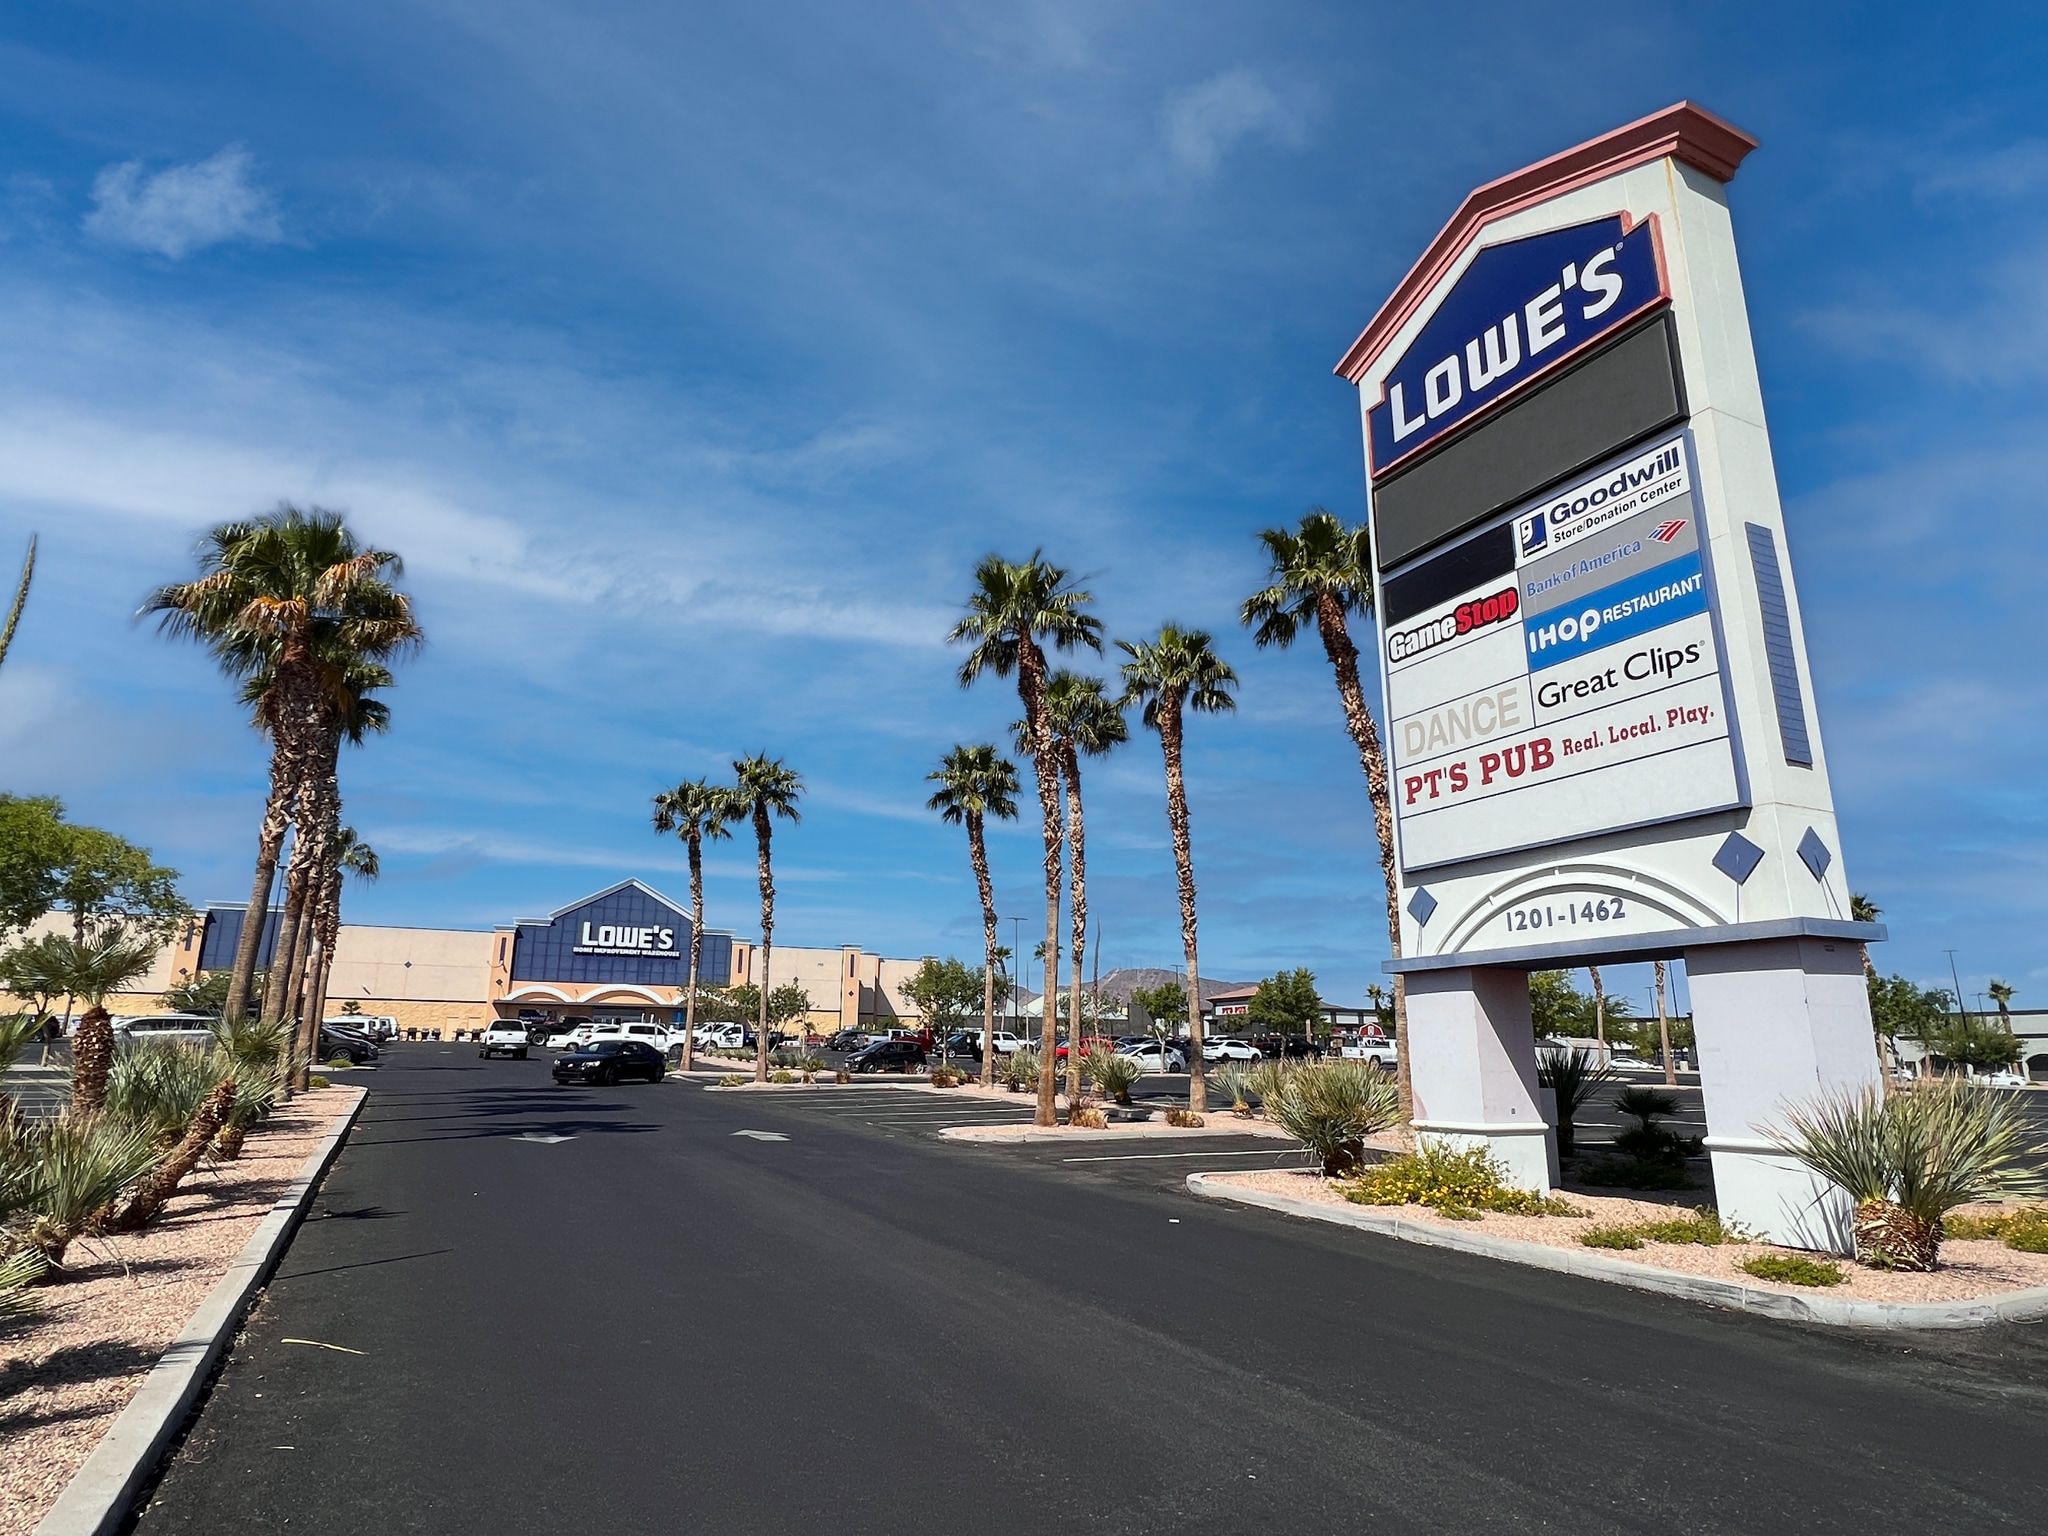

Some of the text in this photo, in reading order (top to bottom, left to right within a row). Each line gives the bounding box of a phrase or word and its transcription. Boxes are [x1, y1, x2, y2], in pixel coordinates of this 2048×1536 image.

[1390, 247, 1623, 443] LOWE'S
[1549, 447, 1680, 524] Goodwill
[1554, 478, 1682, 543] Store/Donation Center
[1526, 540, 1641, 598] Bank of America
[1388, 587, 1519, 662] GameStop
[1529, 573, 1702, 653] IHOP RESTAURANT
[1538, 643, 1700, 708] Great Clips
[1404, 687, 1520, 757] DANCE
[1405, 705, 1714, 805] PT'S PUB Real. Local. Play.
[582, 921, 673, 949] LOWE'S
[1506, 898, 1626, 931] 1201-1462
[594, 947, 641, 955] IMPROVEMENT
